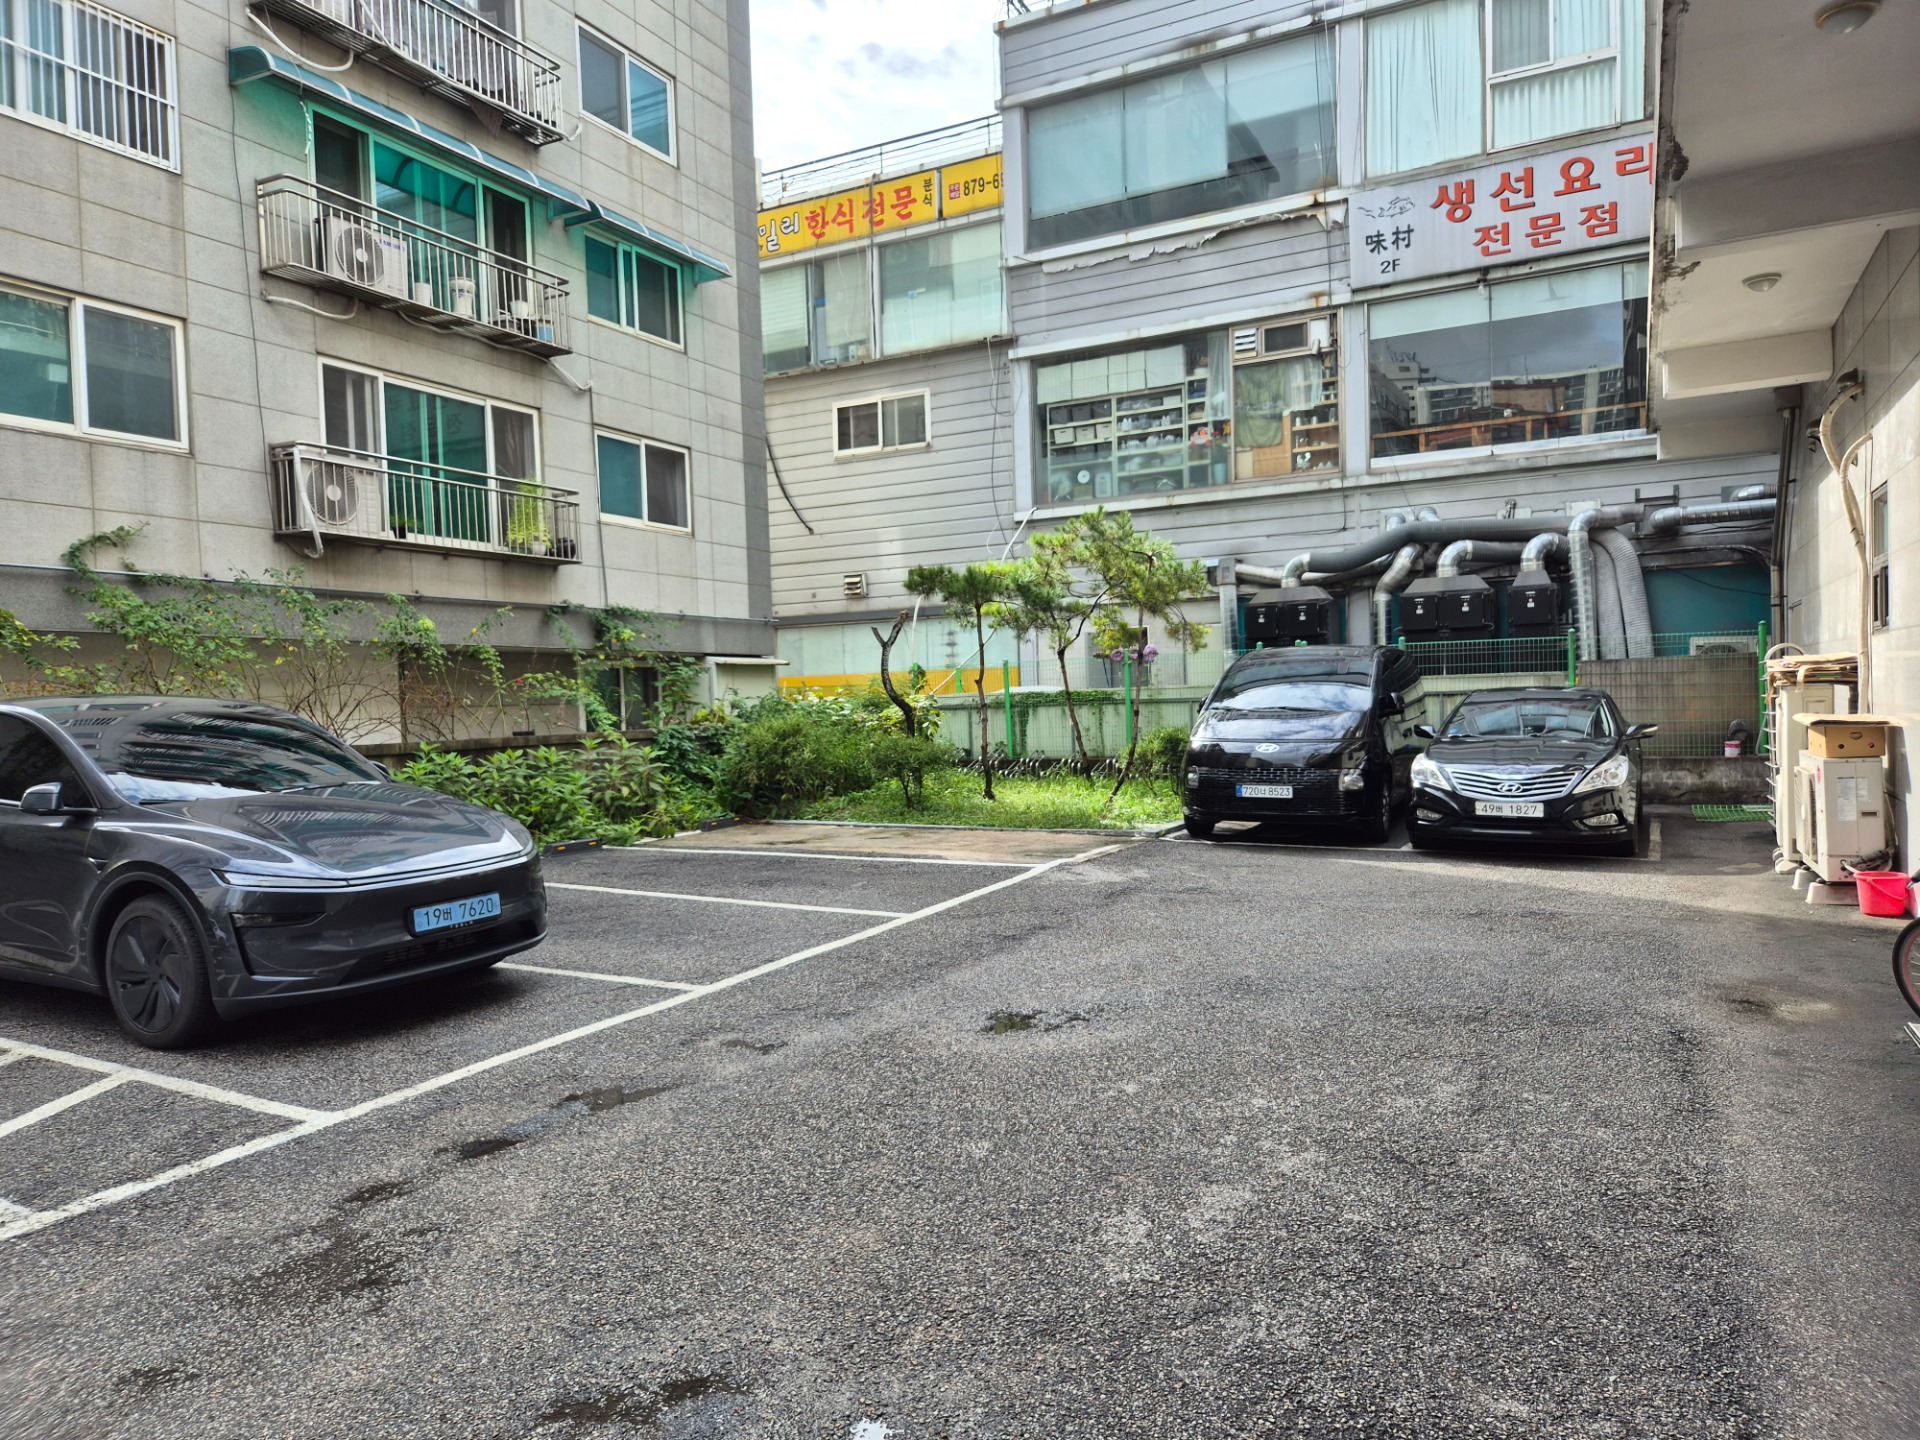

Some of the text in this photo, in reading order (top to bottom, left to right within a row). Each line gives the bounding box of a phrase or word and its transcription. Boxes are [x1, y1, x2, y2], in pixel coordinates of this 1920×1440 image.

[1430, 142, 1653, 224] 생선요리
[1365, 223, 1415, 255] 味村
[1473, 201, 1619, 258] 전문점
[1380, 258, 1401, 275] 2F
[1268, 786, 1291, 797] 8523
[1481, 803, 1538, 815] 49버 1827
[424, 897, 494, 927] 19버 7620
